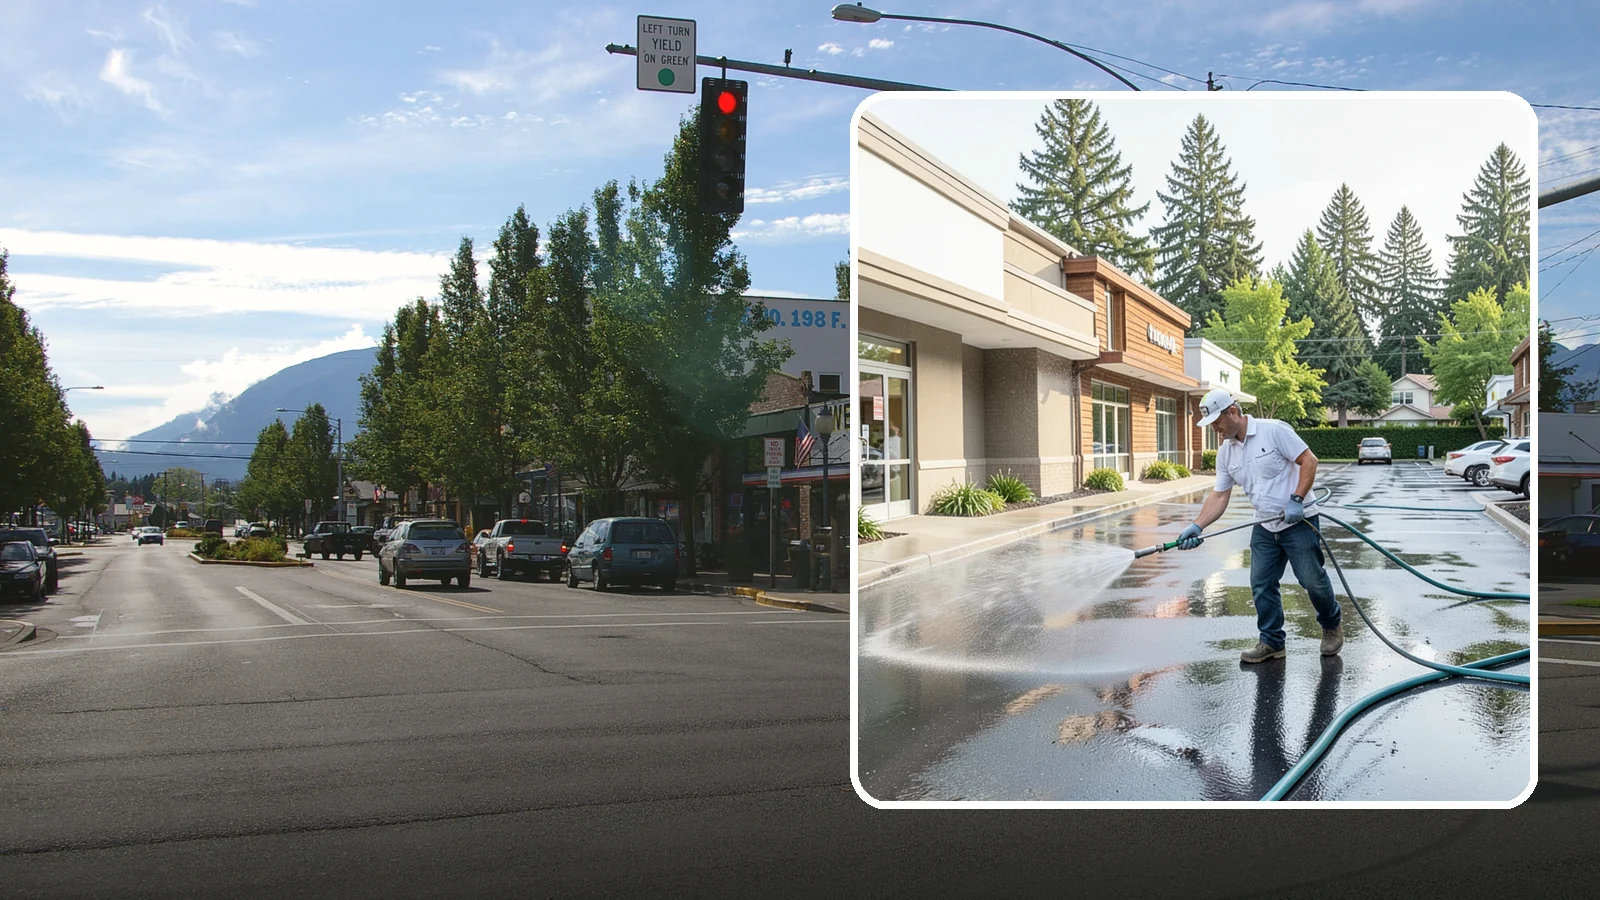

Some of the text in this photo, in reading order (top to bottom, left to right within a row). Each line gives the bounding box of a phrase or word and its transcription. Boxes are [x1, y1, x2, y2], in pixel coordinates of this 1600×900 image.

[643, 23, 690, 36] LEFT TURN
[652, 38, 682, 51] YIELD
[644, 53, 689, 66] ON GREEN
[791, 309, 826, 328] 198
[831, 311, 847, 329] F.
